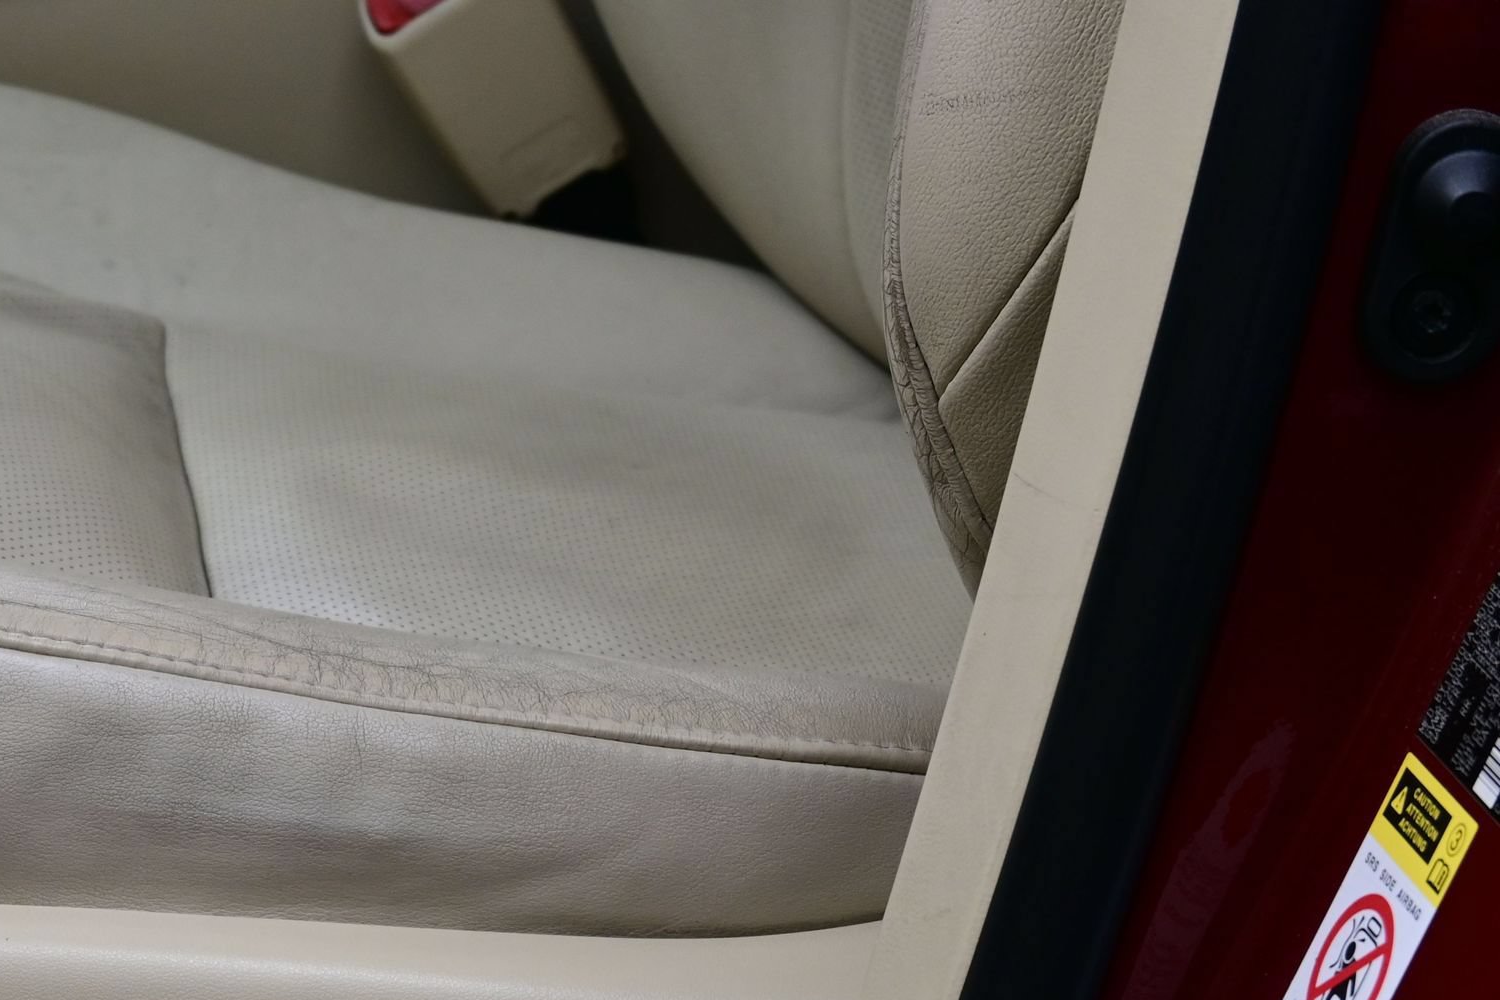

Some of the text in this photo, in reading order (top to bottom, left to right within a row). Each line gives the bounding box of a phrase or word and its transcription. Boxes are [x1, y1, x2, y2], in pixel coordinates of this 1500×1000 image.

[1404, 800, 1439, 843] ATTENTION
[1412, 786, 1441, 821] CAUTION
[1397, 816, 1427, 853] ACHTUNG
[1363, 850, 1422, 921] SRS SIDE AIRBAG
